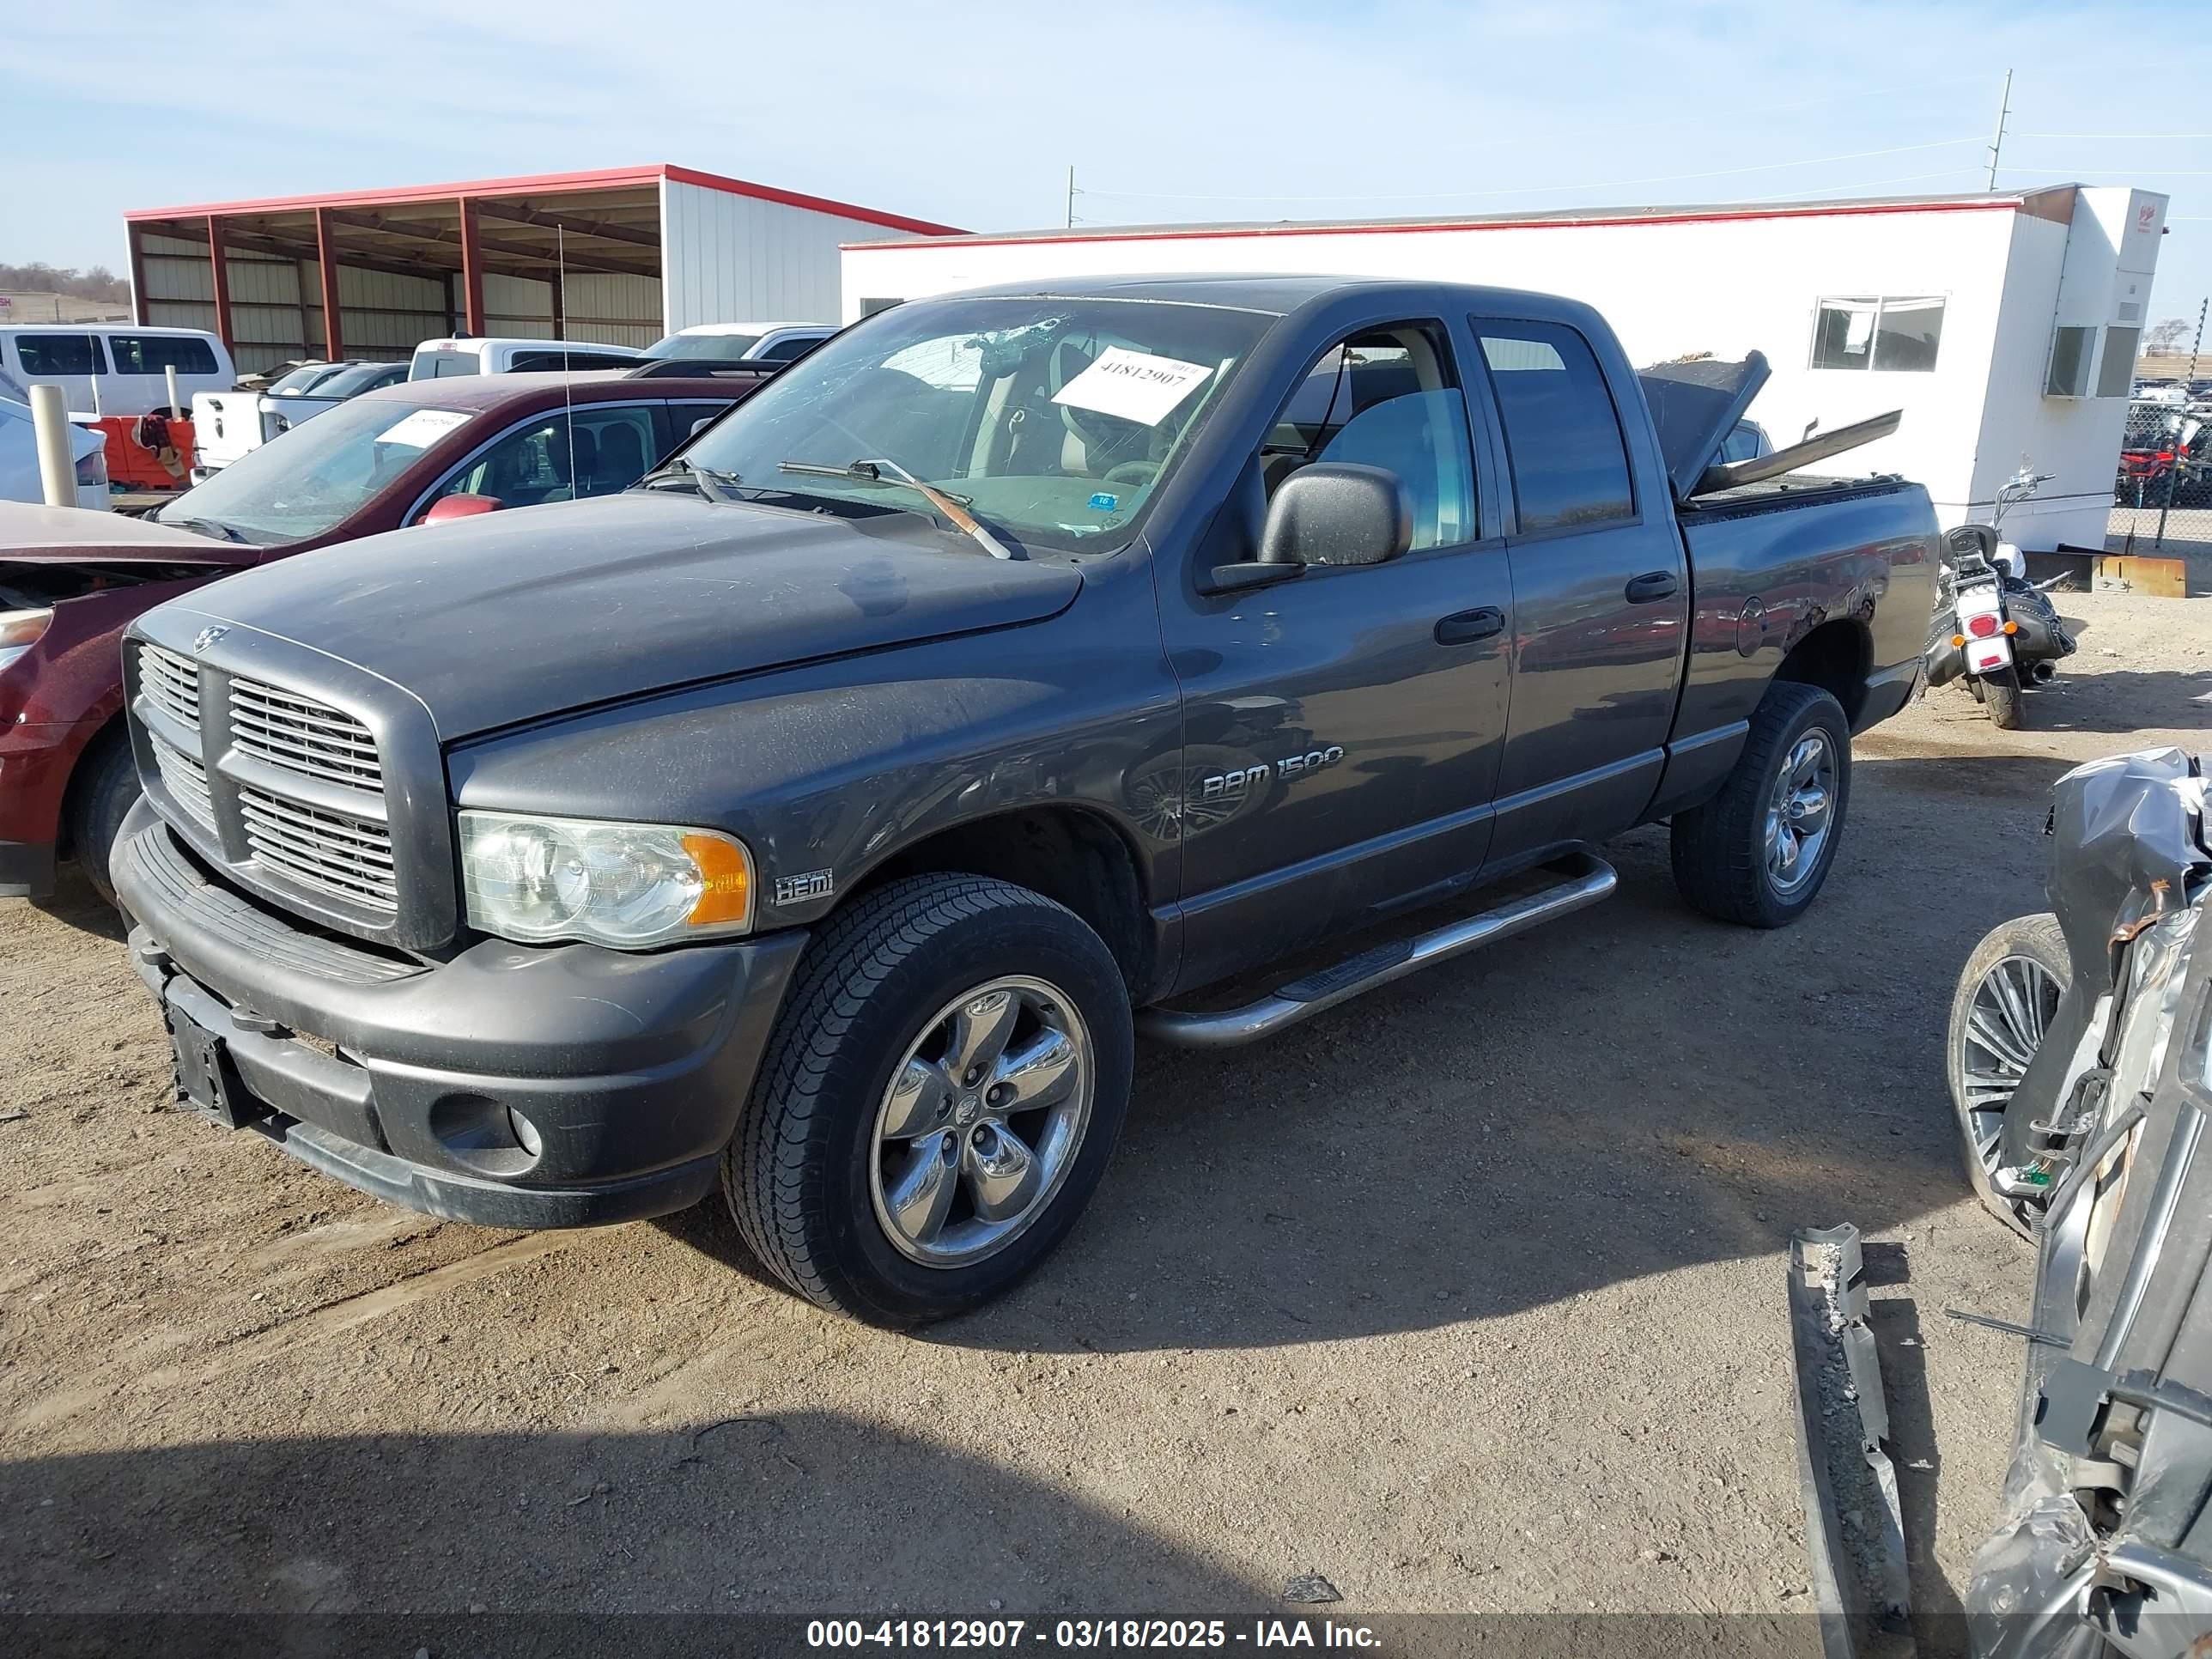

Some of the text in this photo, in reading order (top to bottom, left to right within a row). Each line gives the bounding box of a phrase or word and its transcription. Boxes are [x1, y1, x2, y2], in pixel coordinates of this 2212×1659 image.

[1100, 362, 1187, 386] 41812907
[1203, 746, 1344, 798] RAM 1500
[775, 874, 833, 901] HEMI
